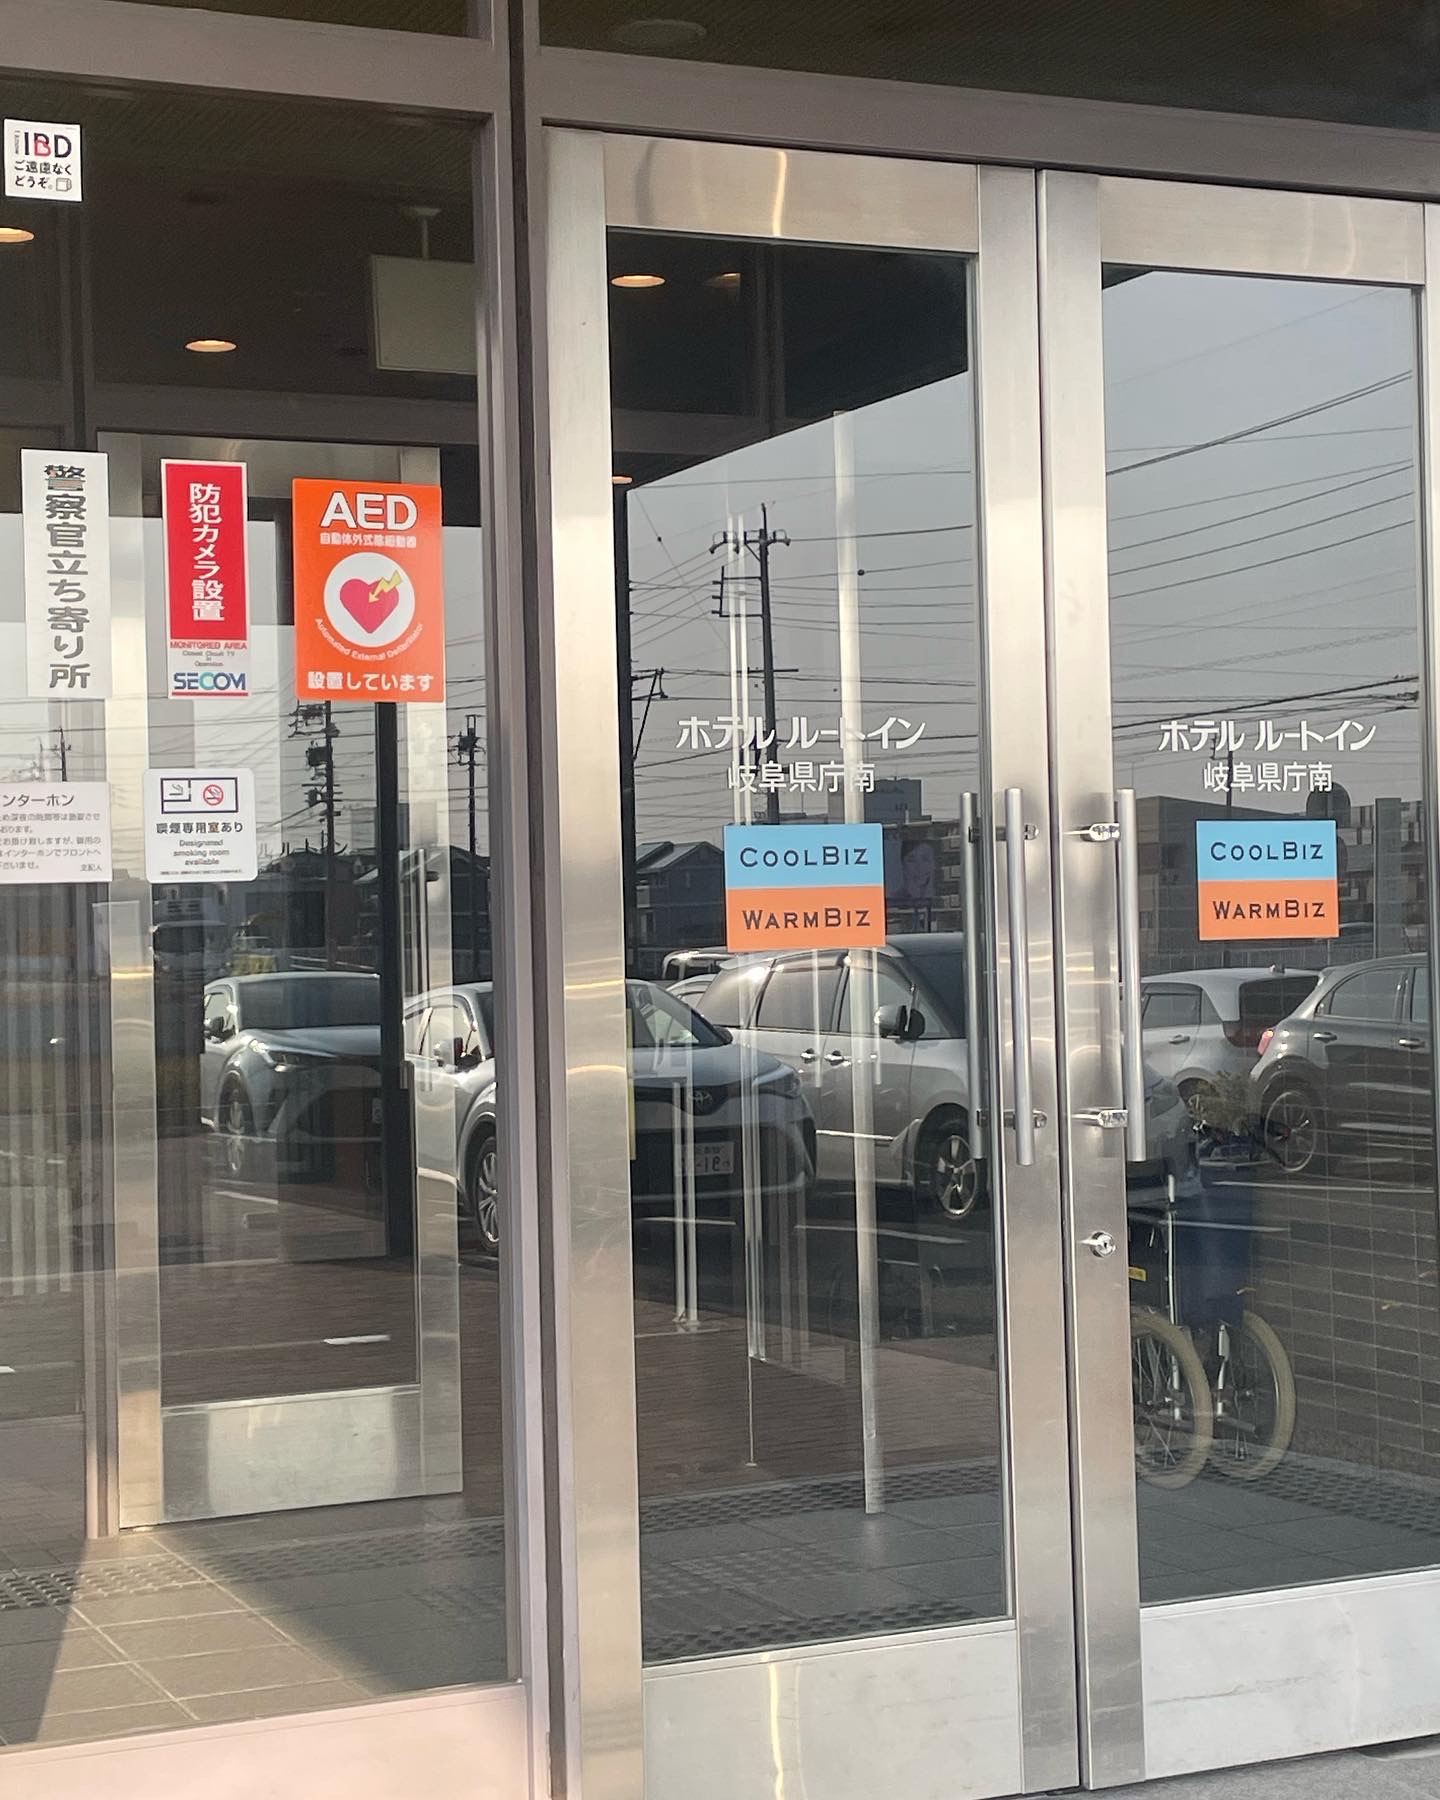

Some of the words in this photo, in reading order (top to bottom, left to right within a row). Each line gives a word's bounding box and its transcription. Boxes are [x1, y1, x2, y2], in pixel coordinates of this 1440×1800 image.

[24, 132, 72, 158] IBD
[15, 160, 72, 175] ご遠慮なく
[320, 490, 418, 531] AED
[188, 483, 225, 622] 防犯カメラ設置
[44, 464, 91, 689] 警察官立ち寄り所
[170, 641, 221, 650] MONITORED
[224, 642, 247, 650] AREA
[351, 650, 386, 661] External
[173, 672, 246, 691] SECOM
[308, 671, 434, 692] 設置しています
[675, 716, 776, 749] ホテル
[785, 716, 926, 749] ルートイン
[1158, 720, 1246, 751] ホテル
[1253, 720, 1377, 751] ルートイン
[727, 761, 876, 793] 岐阜県庁南
[1203, 761, 1333, 793] 岐阜県庁南
[156, 822, 243, 834] 喫煙専用室あり
[179, 839, 224, 847] Designated
[184, 858, 219, 866] available
